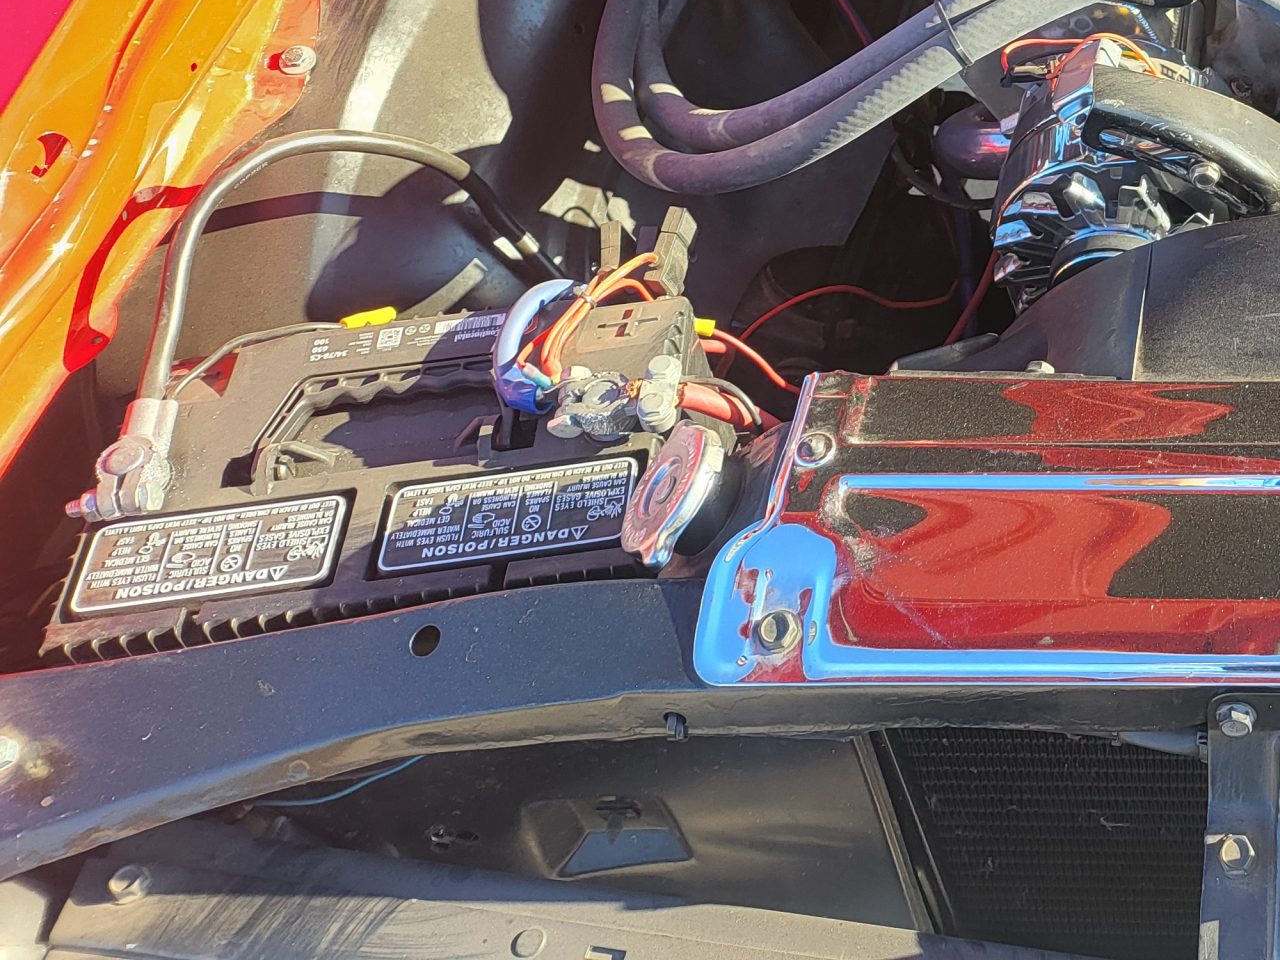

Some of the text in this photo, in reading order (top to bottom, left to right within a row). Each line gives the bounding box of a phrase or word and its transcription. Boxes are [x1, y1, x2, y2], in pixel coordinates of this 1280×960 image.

[233, 161, 269, 190] COPPER
[454, 329, 498, 342] Continental
[311, 345, 328, 353] 650
[309, 350, 347, 361] 34/78-CS
[566, 477, 626, 491] CAN CAUSE INJURY
[482, 493, 517, 503] BLINDNESS
[526, 488, 551, 497] FLAMES
[555, 486, 625, 502] EXPLOSIVE GASES
[415, 497, 433, 506] FAST
[524, 495, 549, 504] SPARKS
[554, 497, 604, 510] SHIELD EYES
[481, 502, 501, 510] CAUSE
[528, 504, 539, 512] NO
[286, 509, 334, 522] OR BLINDNESS
[411, 507, 431, 517] HELP
[227, 520, 257, 530] SMOKING
[270, 516, 332, 531] CAN CAUSE INJURY
[405, 515, 450, 527] GET MEDICAL
[491, 517, 511, 527] ACID
[228, 527, 255, 537] FLAMES
[257, 525, 330, 542] EXPLOSIVE GASES
[390, 524, 460, 540] WATER IMMEDIATELY
[470, 525, 509, 538] SULFURIC
[115, 536, 134, 545] FAST
[185, 532, 220, 543] BLINDNESS
[226, 535, 253, 545] SPARKS
[255, 536, 306, 550] SHIELD EYES
[395, 532, 458, 548] FLUSH EYES WITH
[420, 527, 569, 558] DANGER/POISON
[181, 539, 218, 550] CAN CAUSE
[229, 543, 242, 552] NO
[111, 546, 131, 556] HELP
[103, 554, 150, 568] GET MEDICAL
[190, 557, 211, 567] ACID
[85, 563, 159, 580] WATER IMMEDIATELY
[167, 565, 208, 579] SULFURIC
[89, 572, 156, 588] FLUSH EYES WITH
[114, 567, 269, 600] DANGER/POISON
